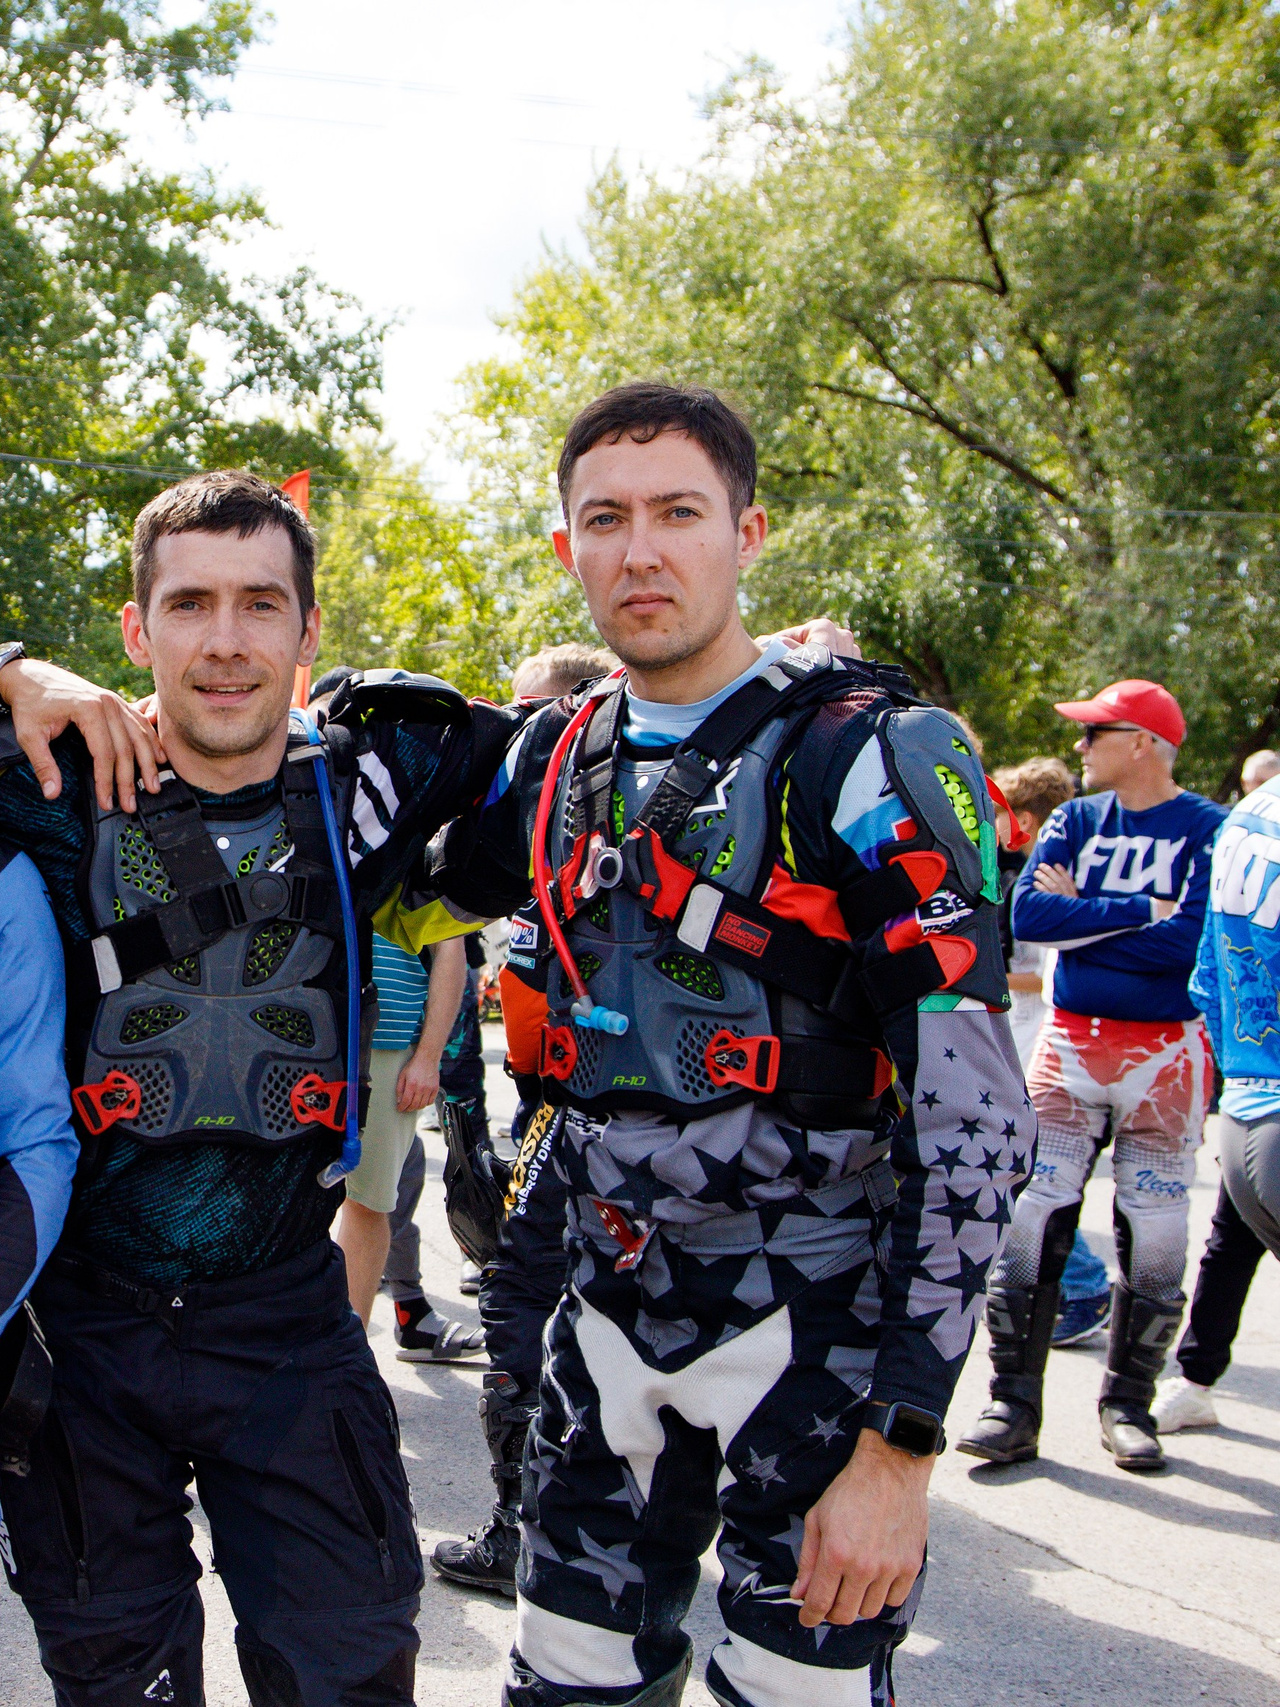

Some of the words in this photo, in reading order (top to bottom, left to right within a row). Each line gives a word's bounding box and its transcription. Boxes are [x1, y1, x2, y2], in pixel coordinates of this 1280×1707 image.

[1075, 834, 1187, 894] FOX
[721, 929, 761, 951] MONKEY
[723, 923, 764, 946] DANCING
[612, 1075, 647, 1086] A-10
[194, 1115, 236, 1126] A-10
